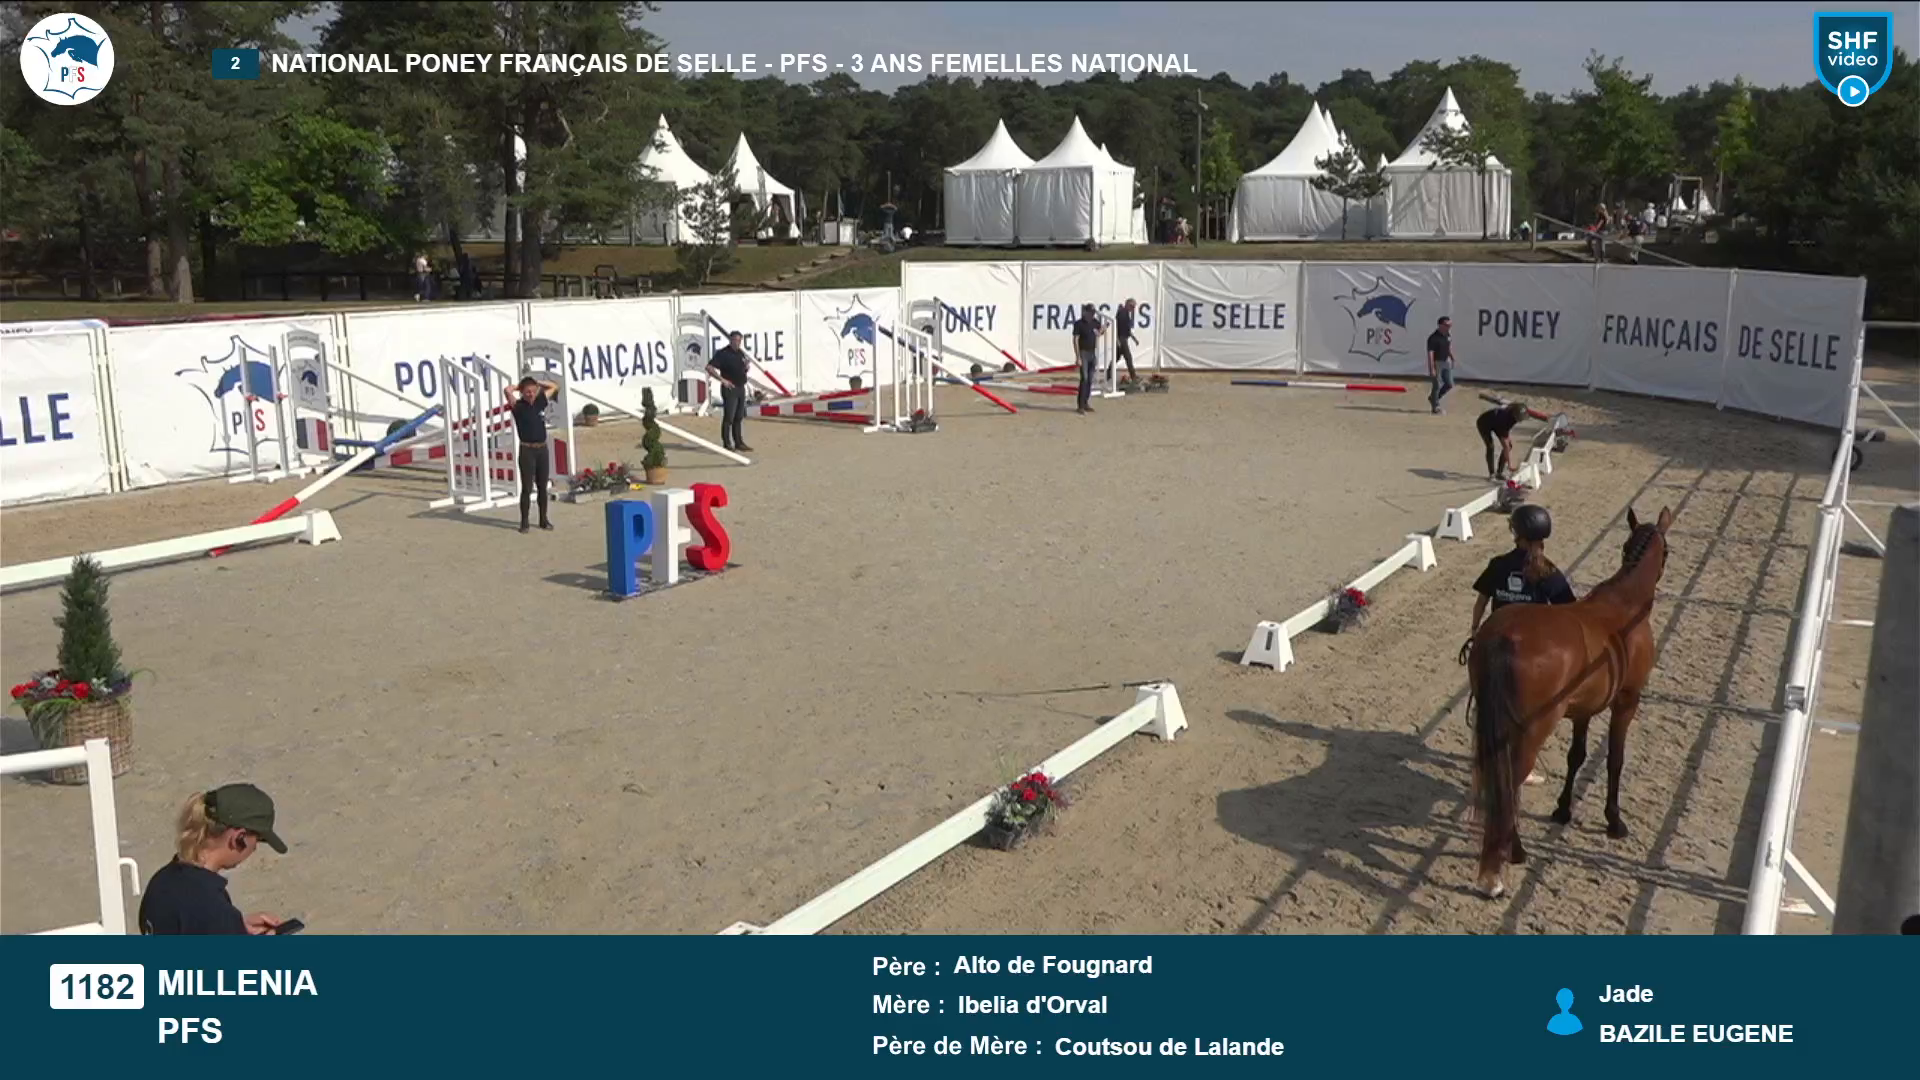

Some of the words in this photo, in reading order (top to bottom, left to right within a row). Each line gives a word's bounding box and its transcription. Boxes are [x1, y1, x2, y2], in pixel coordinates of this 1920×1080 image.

[1174, 303, 1203, 329] DE
[1212, 303, 1286, 330] SELLE
[1478, 308, 1561, 340] PONEY
[1366, 327, 1393, 345] PFS
[1602, 314, 1718, 357] FRANÇAIS
[1738, 324, 1765, 360] DE
[1769, 328, 1841, 371] SELLE
[231, 408, 266, 435] PS
[604, 482, 731, 598] PFS
